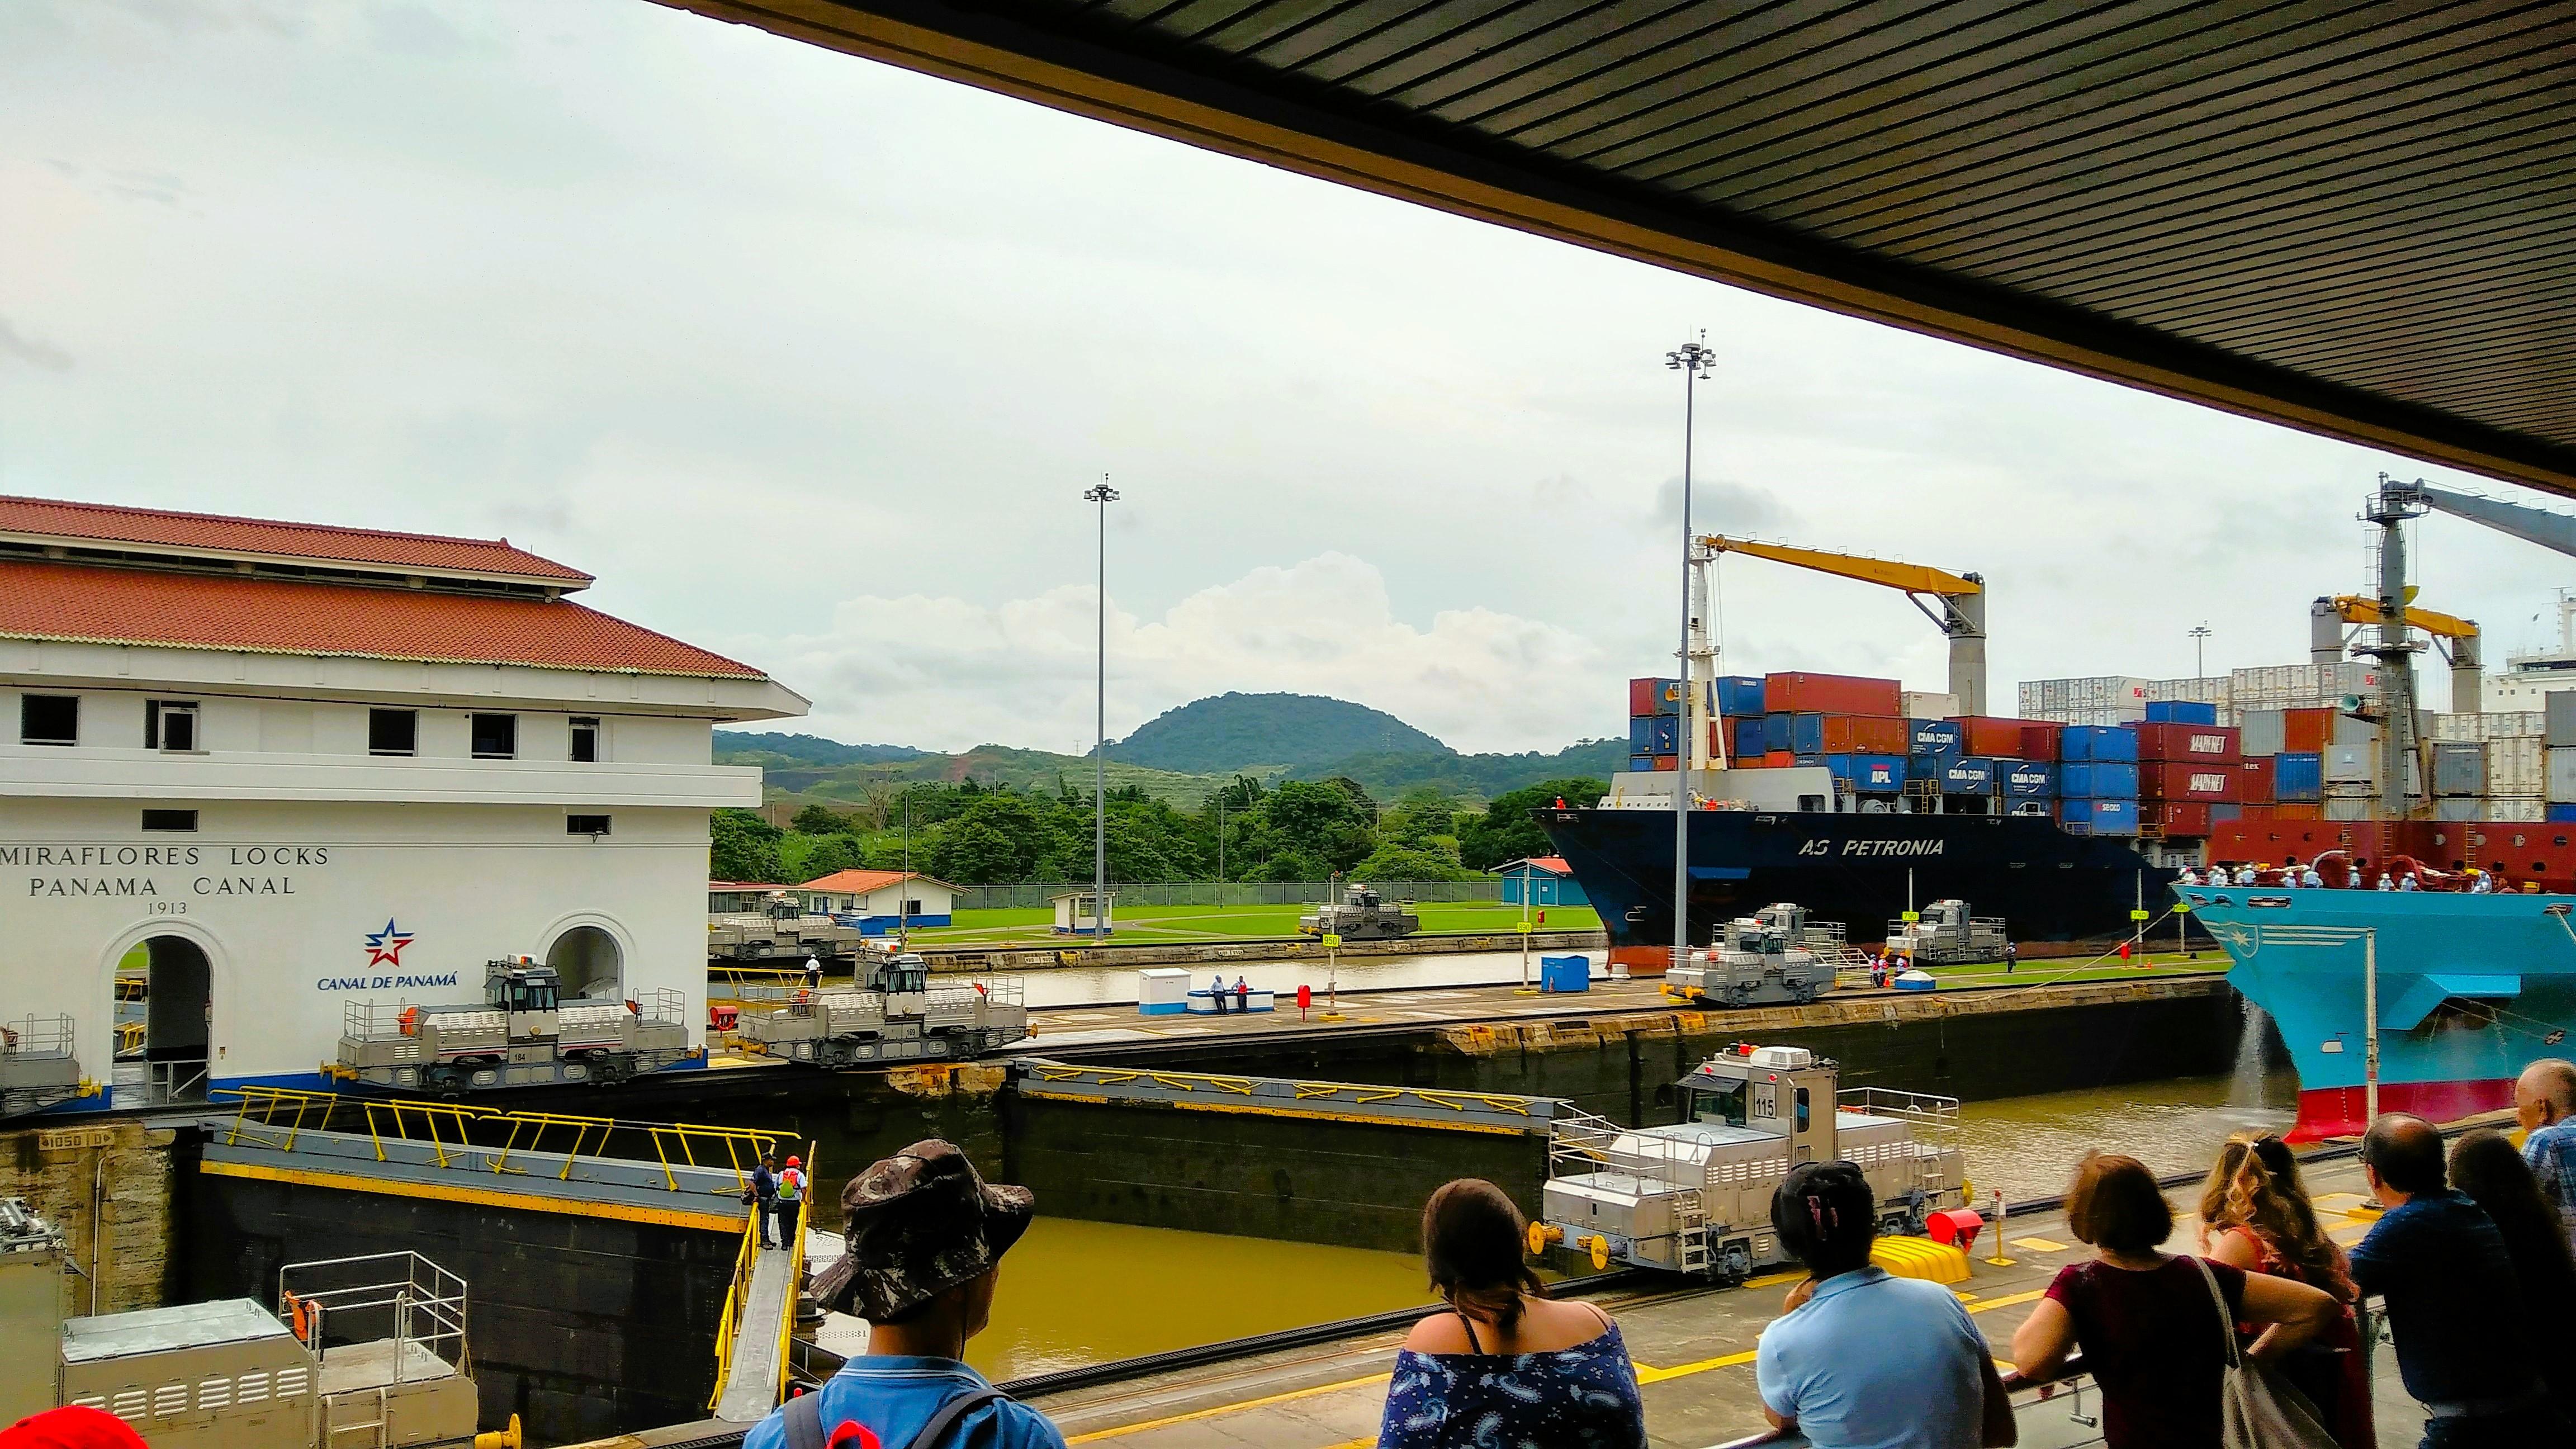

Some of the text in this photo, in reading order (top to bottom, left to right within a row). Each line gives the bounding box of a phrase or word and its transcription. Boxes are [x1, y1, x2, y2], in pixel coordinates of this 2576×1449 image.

[1917, 732, 1953, 744] CMA CGM
[1871, 770, 1891, 783] APL
[1948, 769, 1985, 781] CMA CGM
[2011, 773, 2045, 784] CMA CGM
[1798, 839, 1944, 856] AS PETRONIA
[0, 847, 328, 866] MIRAFLORES LOCKS
[29, 877, 296, 897] PANAMA CANAL
[148, 902, 187, 915] 1913
[1324, 936, 1337, 945] 950
[317, 970, 458, 991] CANAL DE PANAMÁ
[1756, 1098, 1774, 1116] 115
